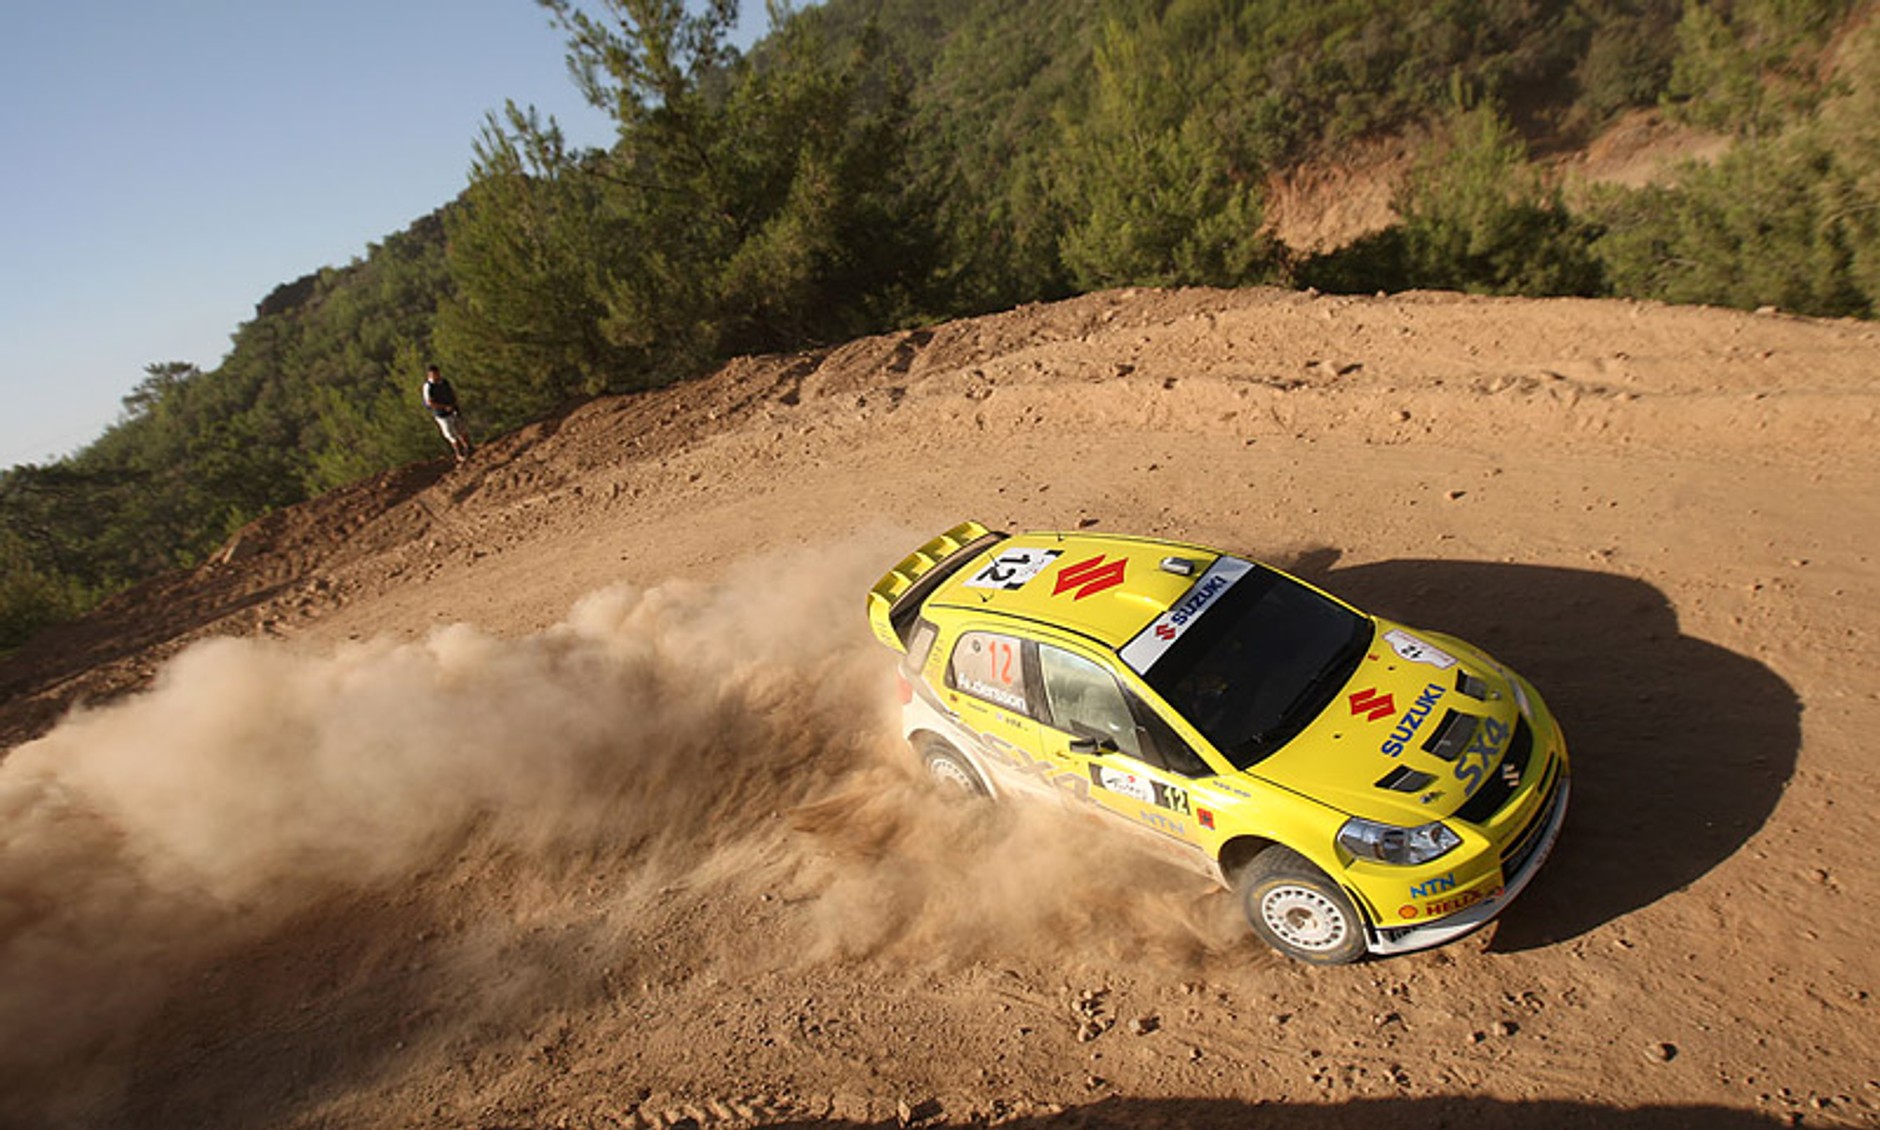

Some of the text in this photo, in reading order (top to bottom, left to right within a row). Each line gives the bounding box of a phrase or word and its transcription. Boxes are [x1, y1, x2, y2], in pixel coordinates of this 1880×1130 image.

[976, 554, 1031, 581] 12
[1170, 575, 1228, 626] SUZUKI
[988, 640, 1013, 685] 12
[1380, 683, 1447, 758] SUZUKI
[1454, 716, 1509, 797] SX4
[1162, 784, 1191, 815] 12
[1140, 809, 1185, 835] NTN
[1410, 872, 1456, 899] NTN
[1426, 889, 1481, 916] HELIX
